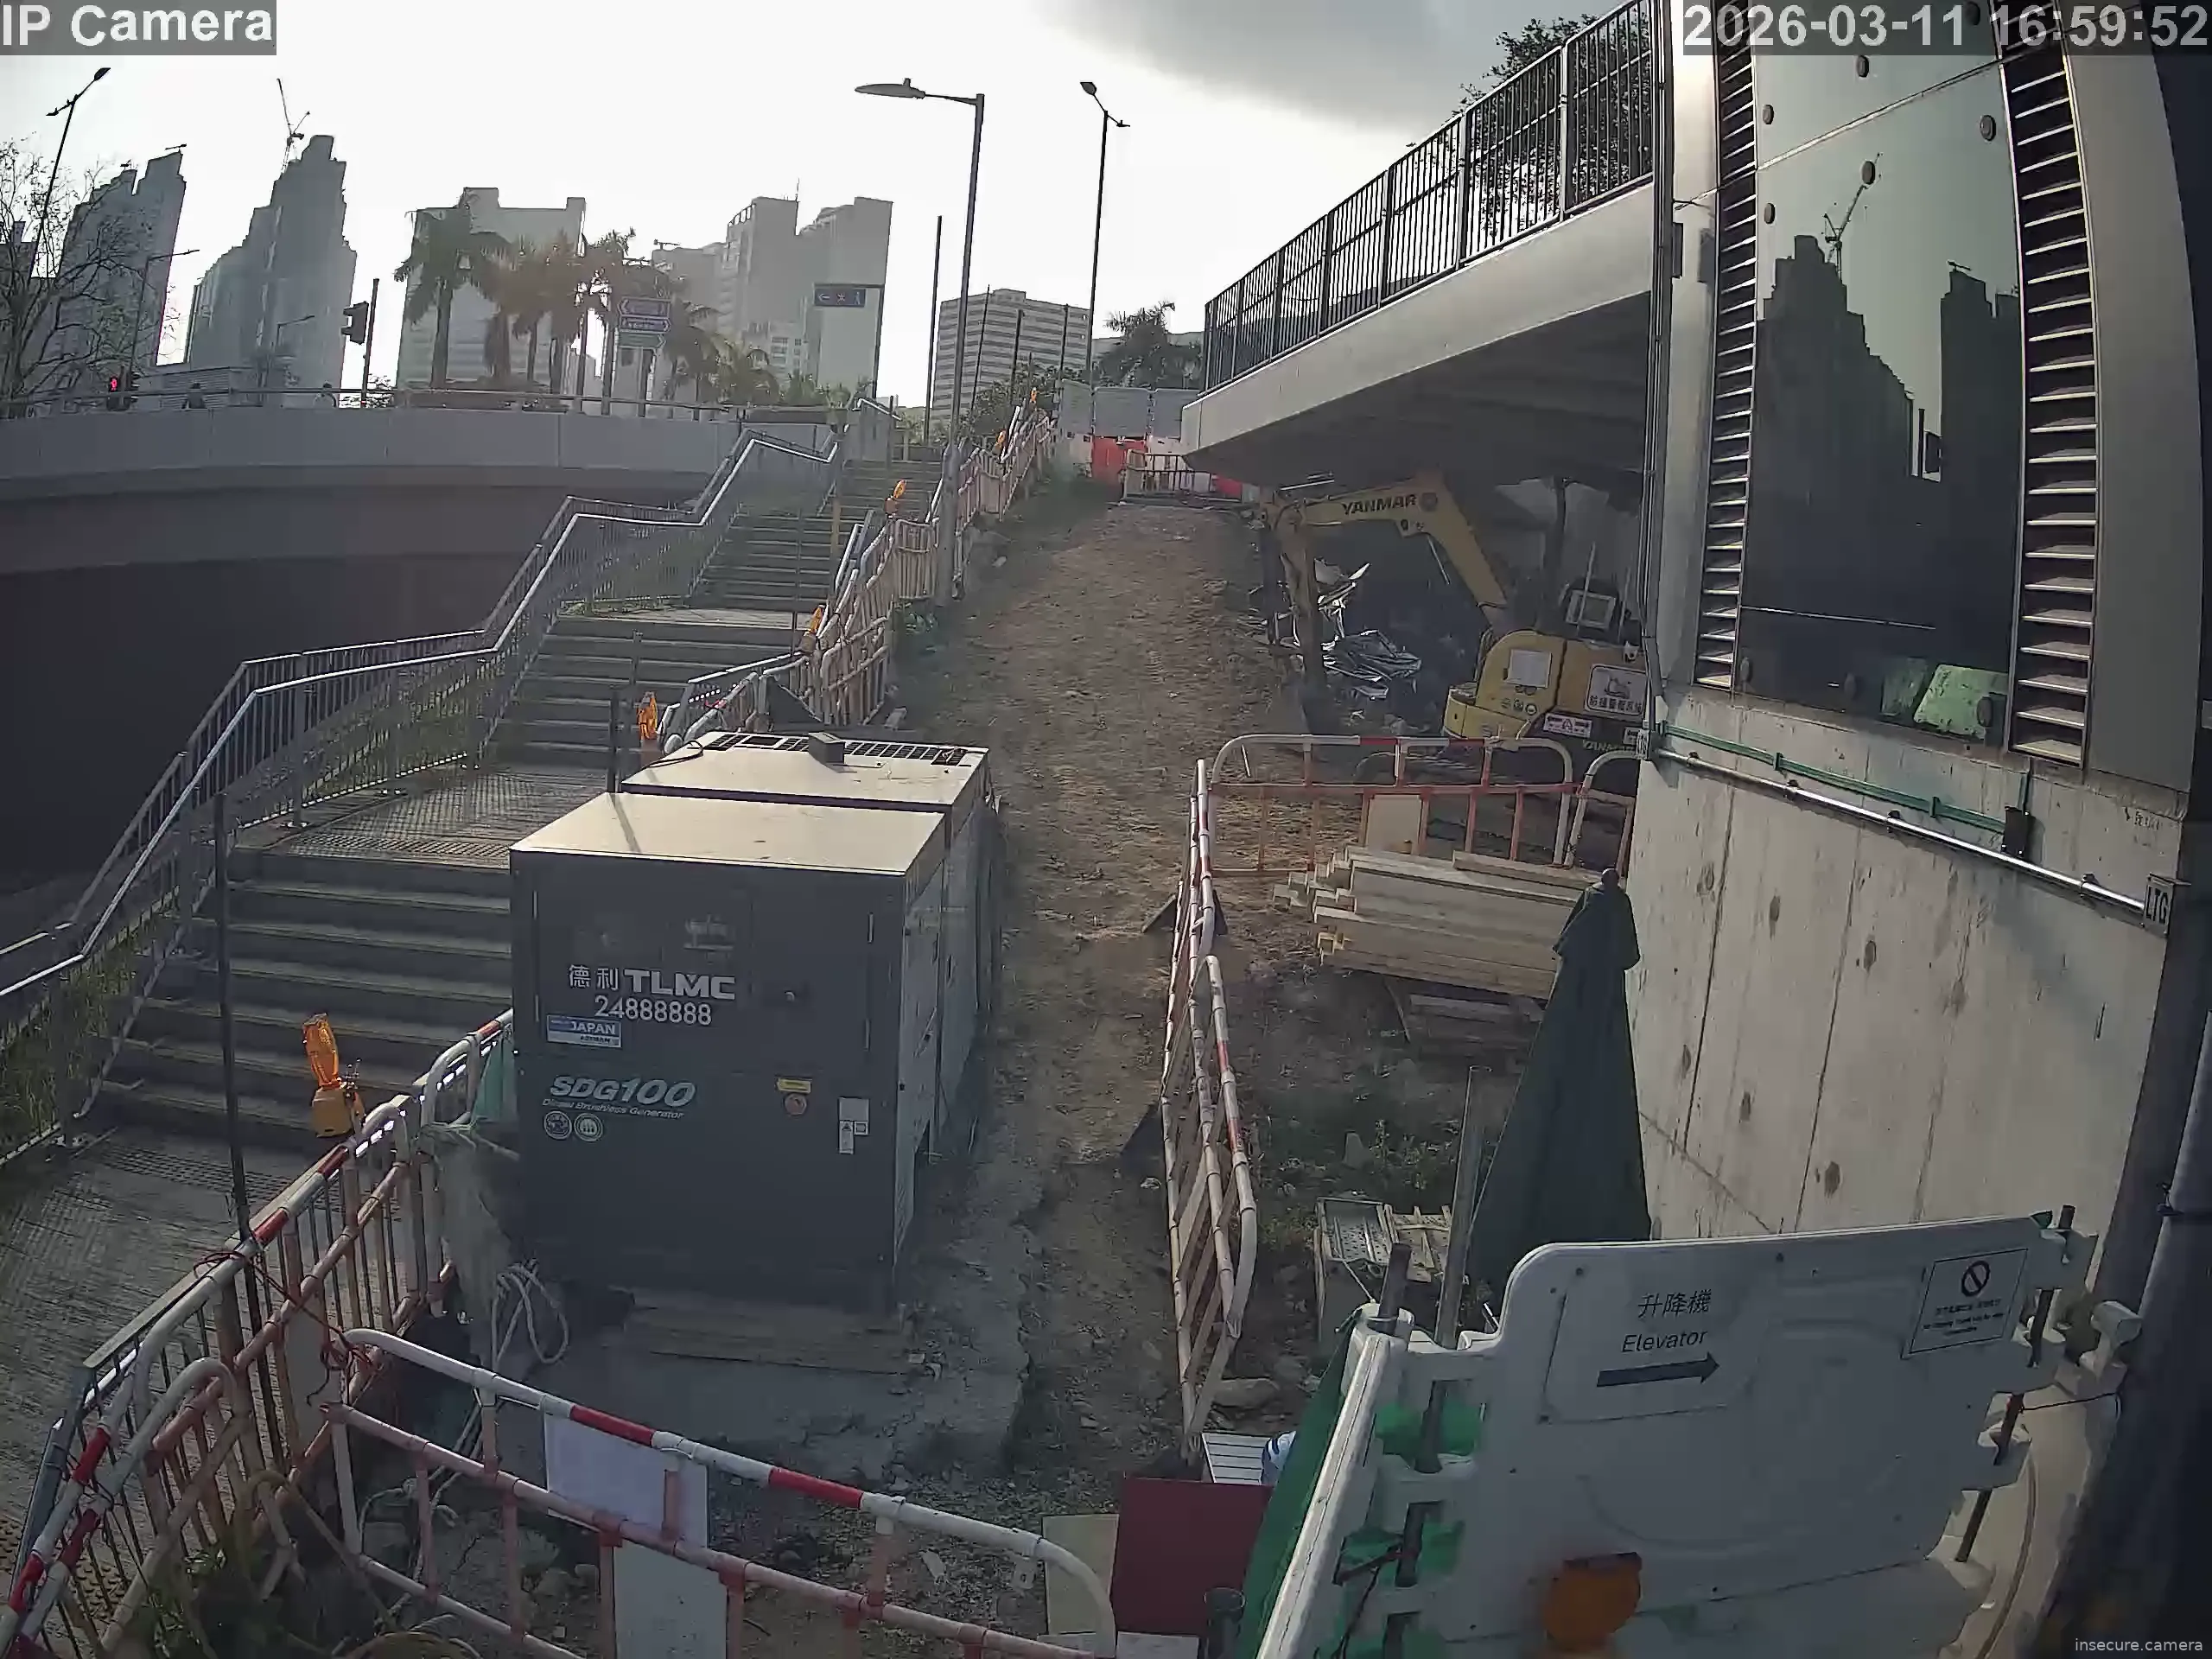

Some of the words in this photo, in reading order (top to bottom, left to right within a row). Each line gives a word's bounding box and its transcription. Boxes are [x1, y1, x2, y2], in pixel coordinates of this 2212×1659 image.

[1341, 493, 1417, 515] YANMAR
[568, 964, 620, 991] 德利
[624, 969, 735, 1000] TLMC
[594, 995, 712, 1026] 24888888
[571, 1020, 616, 1035] JAPAN
[550, 1075, 696, 1107] SDG100
[629, 1107, 685, 1120] Generator
[1638, 1288, 1711, 1319] 升降機
[1622, 1331, 1707, 1352] Elevator
